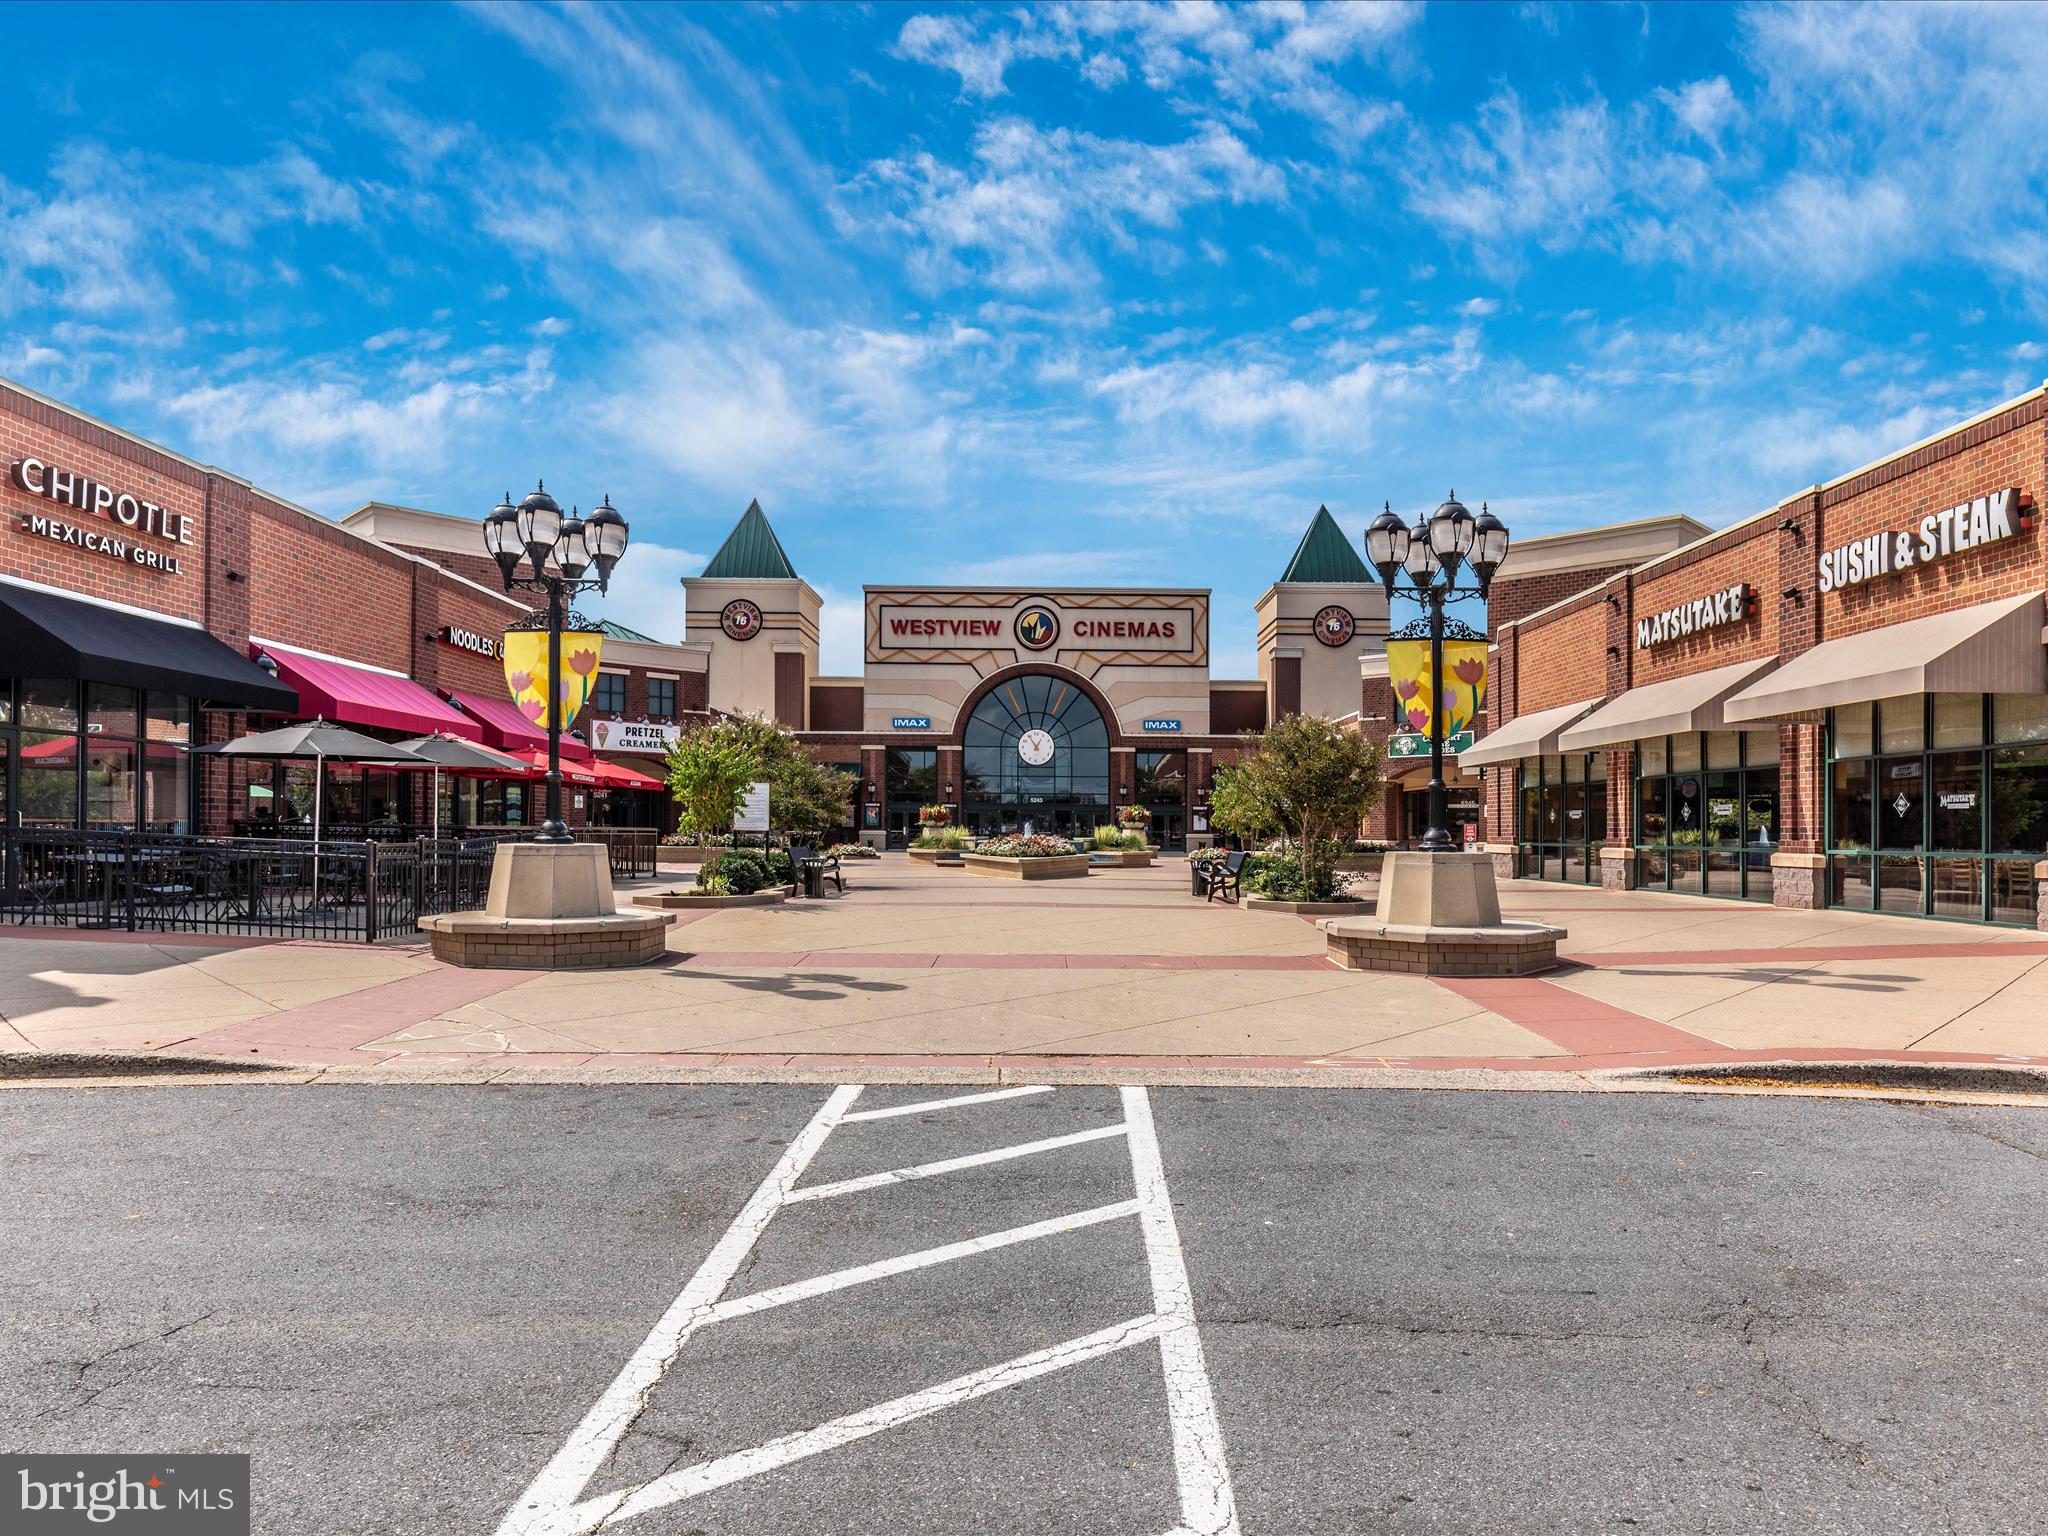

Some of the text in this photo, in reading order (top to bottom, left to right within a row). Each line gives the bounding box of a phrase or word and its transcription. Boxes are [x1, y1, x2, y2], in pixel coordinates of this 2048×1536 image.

[21, 458, 194, 546] CHIPOTLE
[31, 513, 184, 576] MEXICAN GRILL
[1819, 487, 2017, 594] SUSHI & STEAK
[735, 615, 748, 626] 16
[1637, 582, 1745, 650] MATSUTAKE
[890, 618, 1176, 638] WESTVIEW CINEMAS
[1329, 621, 1341, 631] 16
[450, 625, 494, 657] NOODLES
[893, 718, 927, 728] IMAX
[1144, 720, 1178, 729] IMAX
[625, 726, 664, 738] PRETZEL
[619, 738, 671, 749] CREAME
[593, 791, 608, 799] 5241
